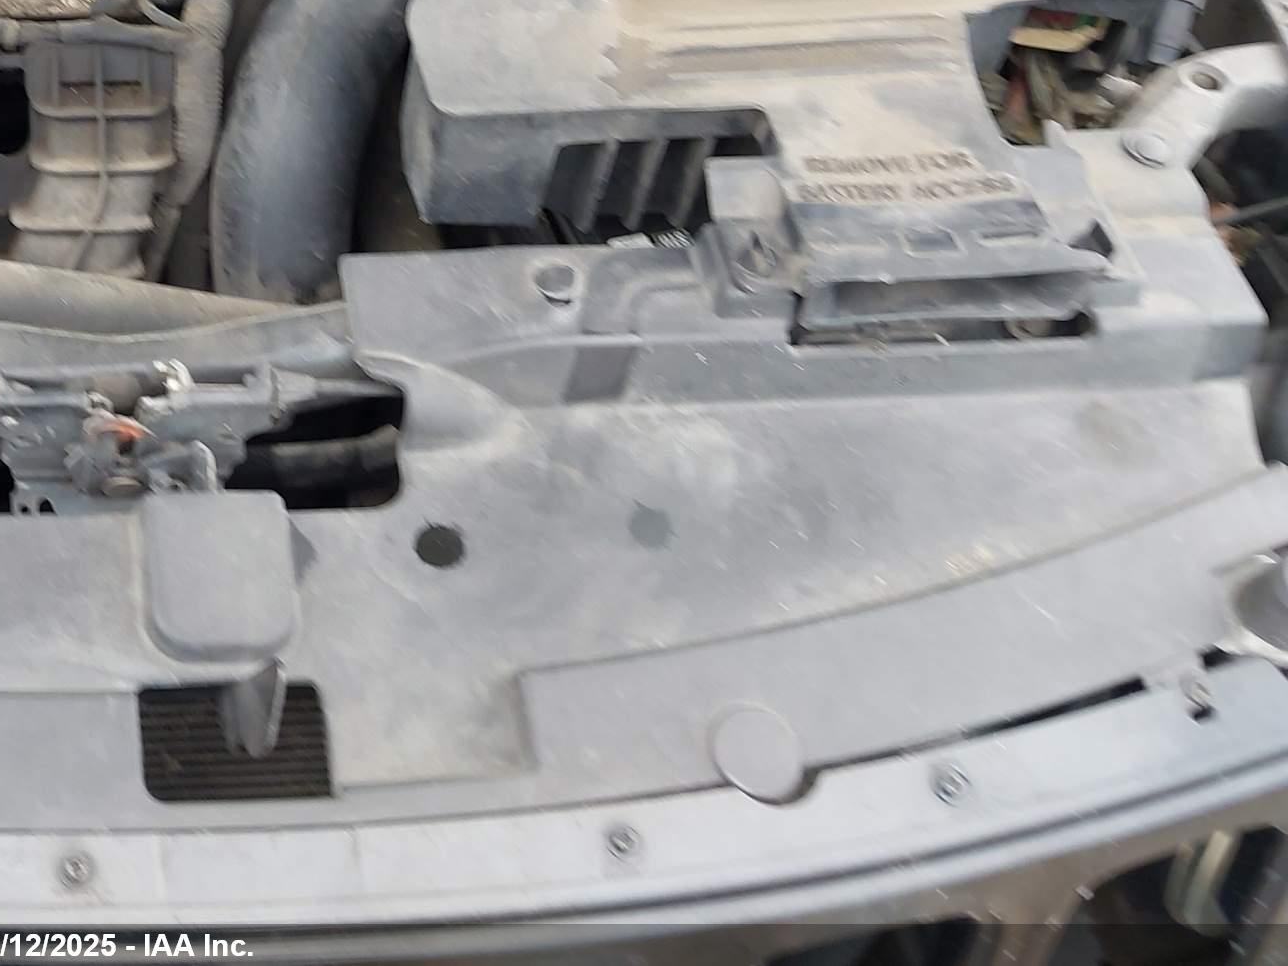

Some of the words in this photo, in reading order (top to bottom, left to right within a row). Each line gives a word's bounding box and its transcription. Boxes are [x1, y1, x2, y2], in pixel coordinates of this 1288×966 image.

[804, 154, 910, 174] REMOVE
[915, 151, 977, 172] FOR
[797, 182, 904, 203] BATTERY
